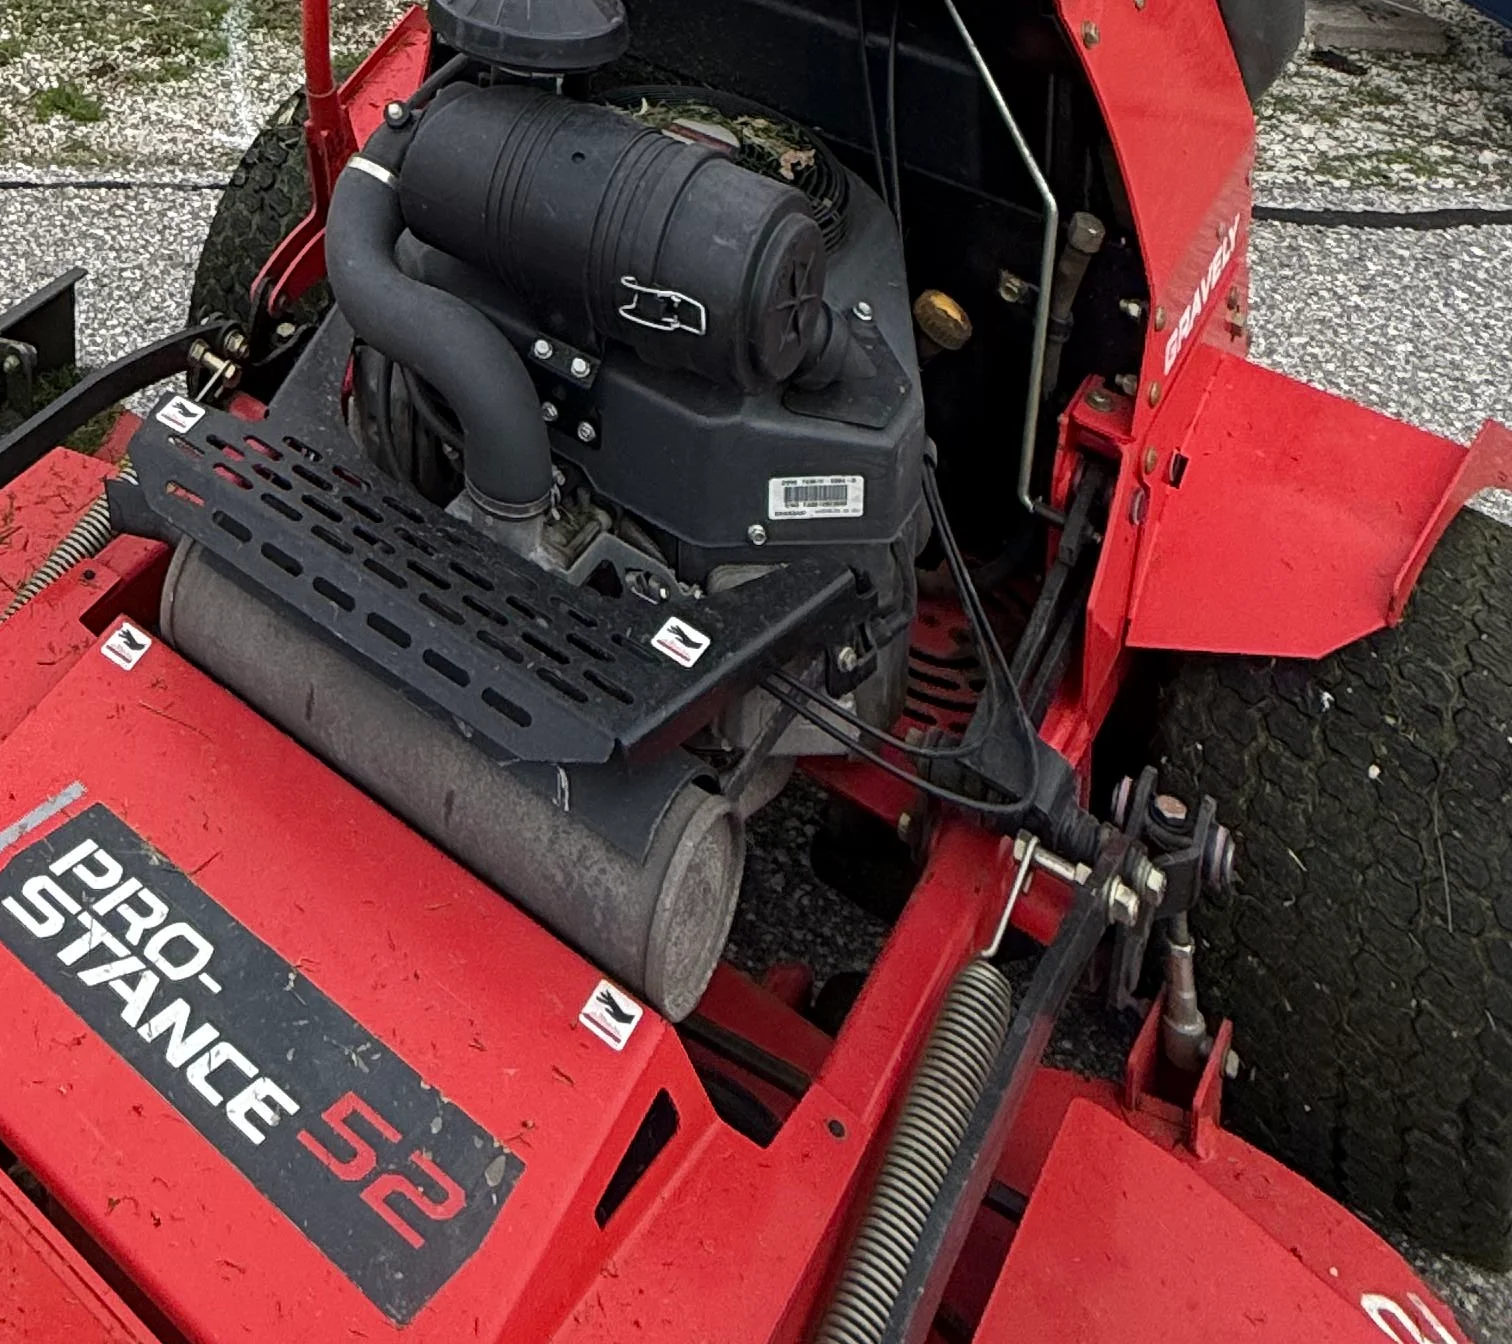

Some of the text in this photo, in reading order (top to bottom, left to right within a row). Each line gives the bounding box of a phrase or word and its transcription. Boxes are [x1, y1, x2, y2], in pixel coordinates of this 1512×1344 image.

[1164, 212, 1240, 375] GRAVELY
[48, 838, 222, 993] PRO-
[1, 875, 467, 1250] STANCE 52
